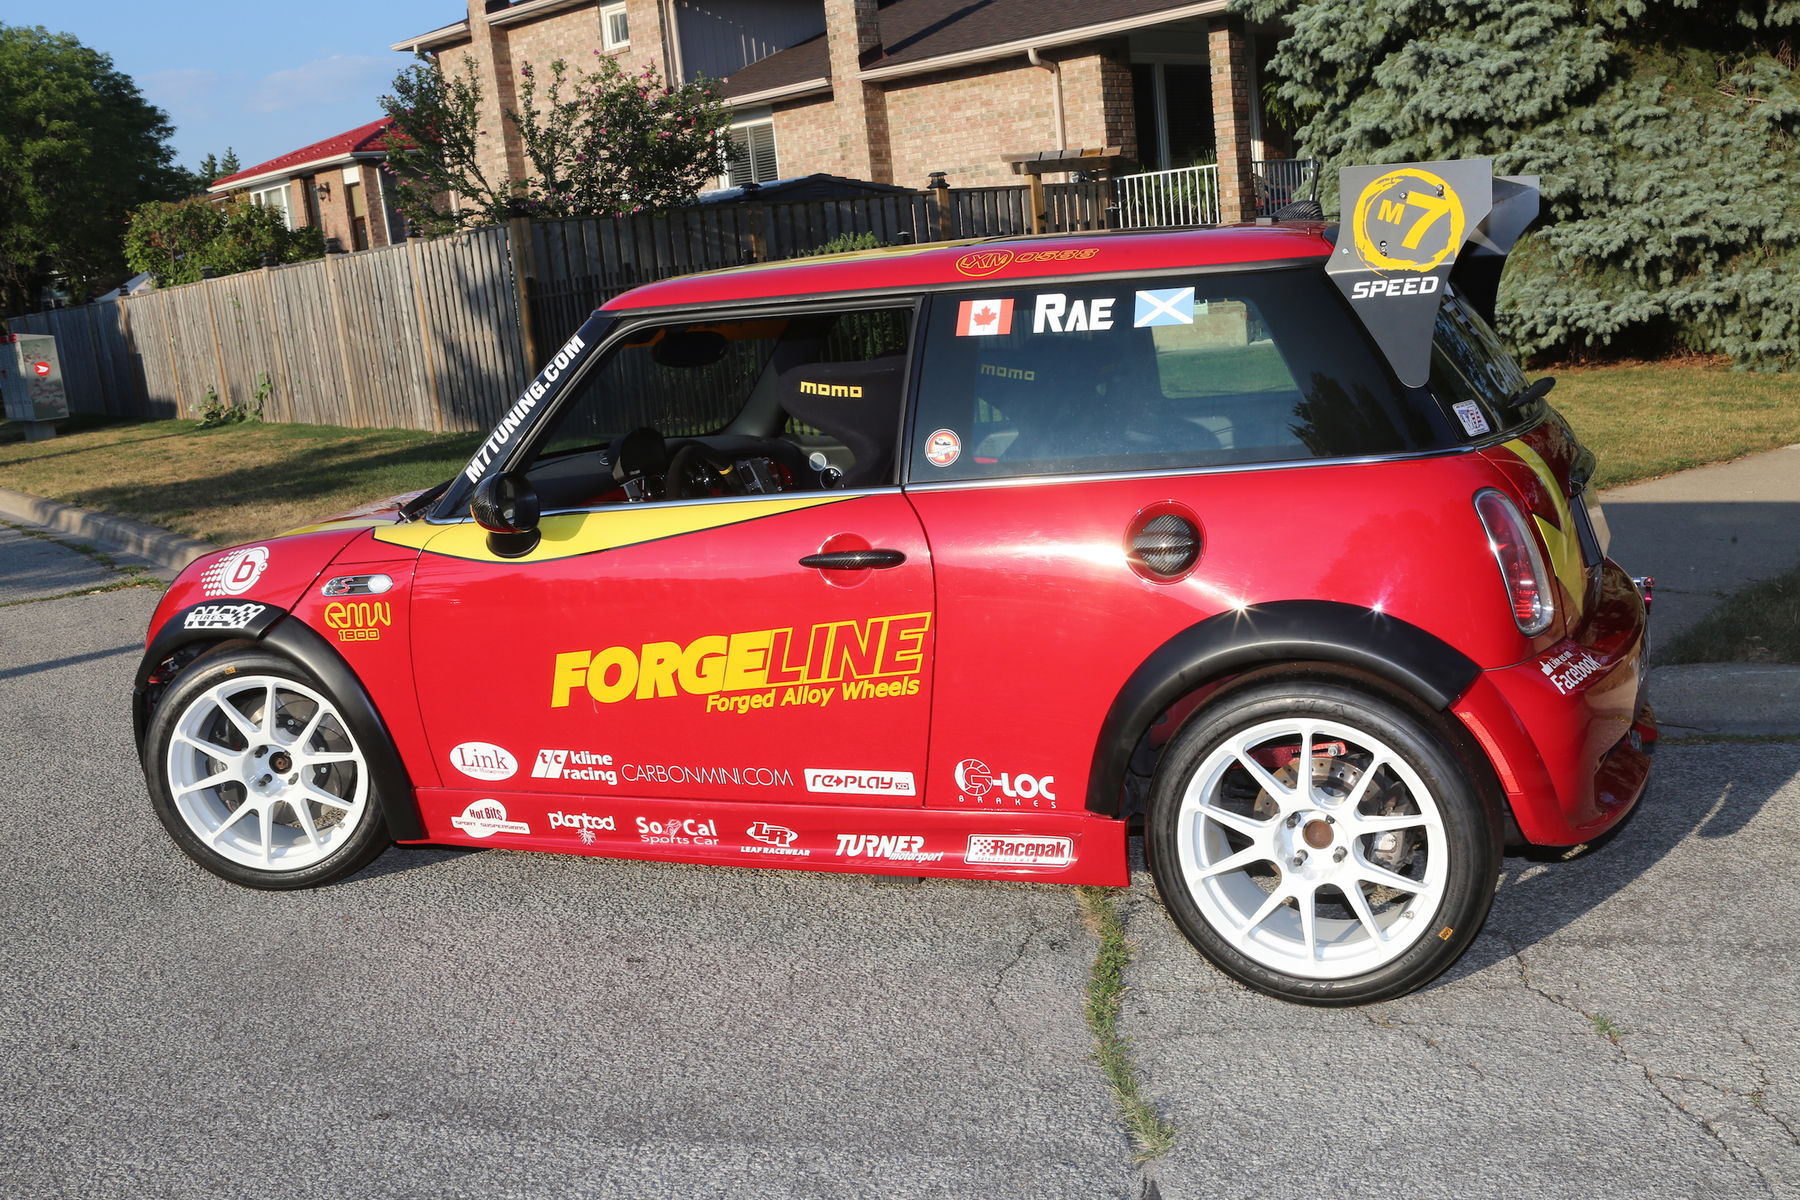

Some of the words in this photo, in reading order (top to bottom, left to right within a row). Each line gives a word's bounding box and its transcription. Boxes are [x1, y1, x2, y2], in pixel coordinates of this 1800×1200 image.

[1351, 276, 1440, 300] SPEED
[465, 334, 586, 484] M7TUNING.COM
[338, 628, 380, 642] 1800
[550, 611, 933, 708] FORGELINE
[1549, 652, 1602, 695] Facebook
[705, 687, 775, 714] Forged
[780, 682, 834, 707] Alloy
[841, 676, 920, 701] Wheels
[457, 747, 509, 769] Link
[569, 750, 613, 765] kline
[562, 767, 618, 785] racing
[621, 763, 794, 787] CARBONMINI.COM
[469, 808, 485, 820] Hot
[484, 806, 503, 821] Bits
[635, 816, 662, 834] So
[683, 818, 718, 837] Cal
[640, 833, 690, 845] Sports
[693, 836, 720, 845] Car
[835, 834, 925, 858] TURNER
[990, 839, 1067, 859] Racepak
[740, 845, 763, 854] LEAF
[762, 846, 811, 857] RACEWEAR
[888, 851, 944, 863] motorsport
